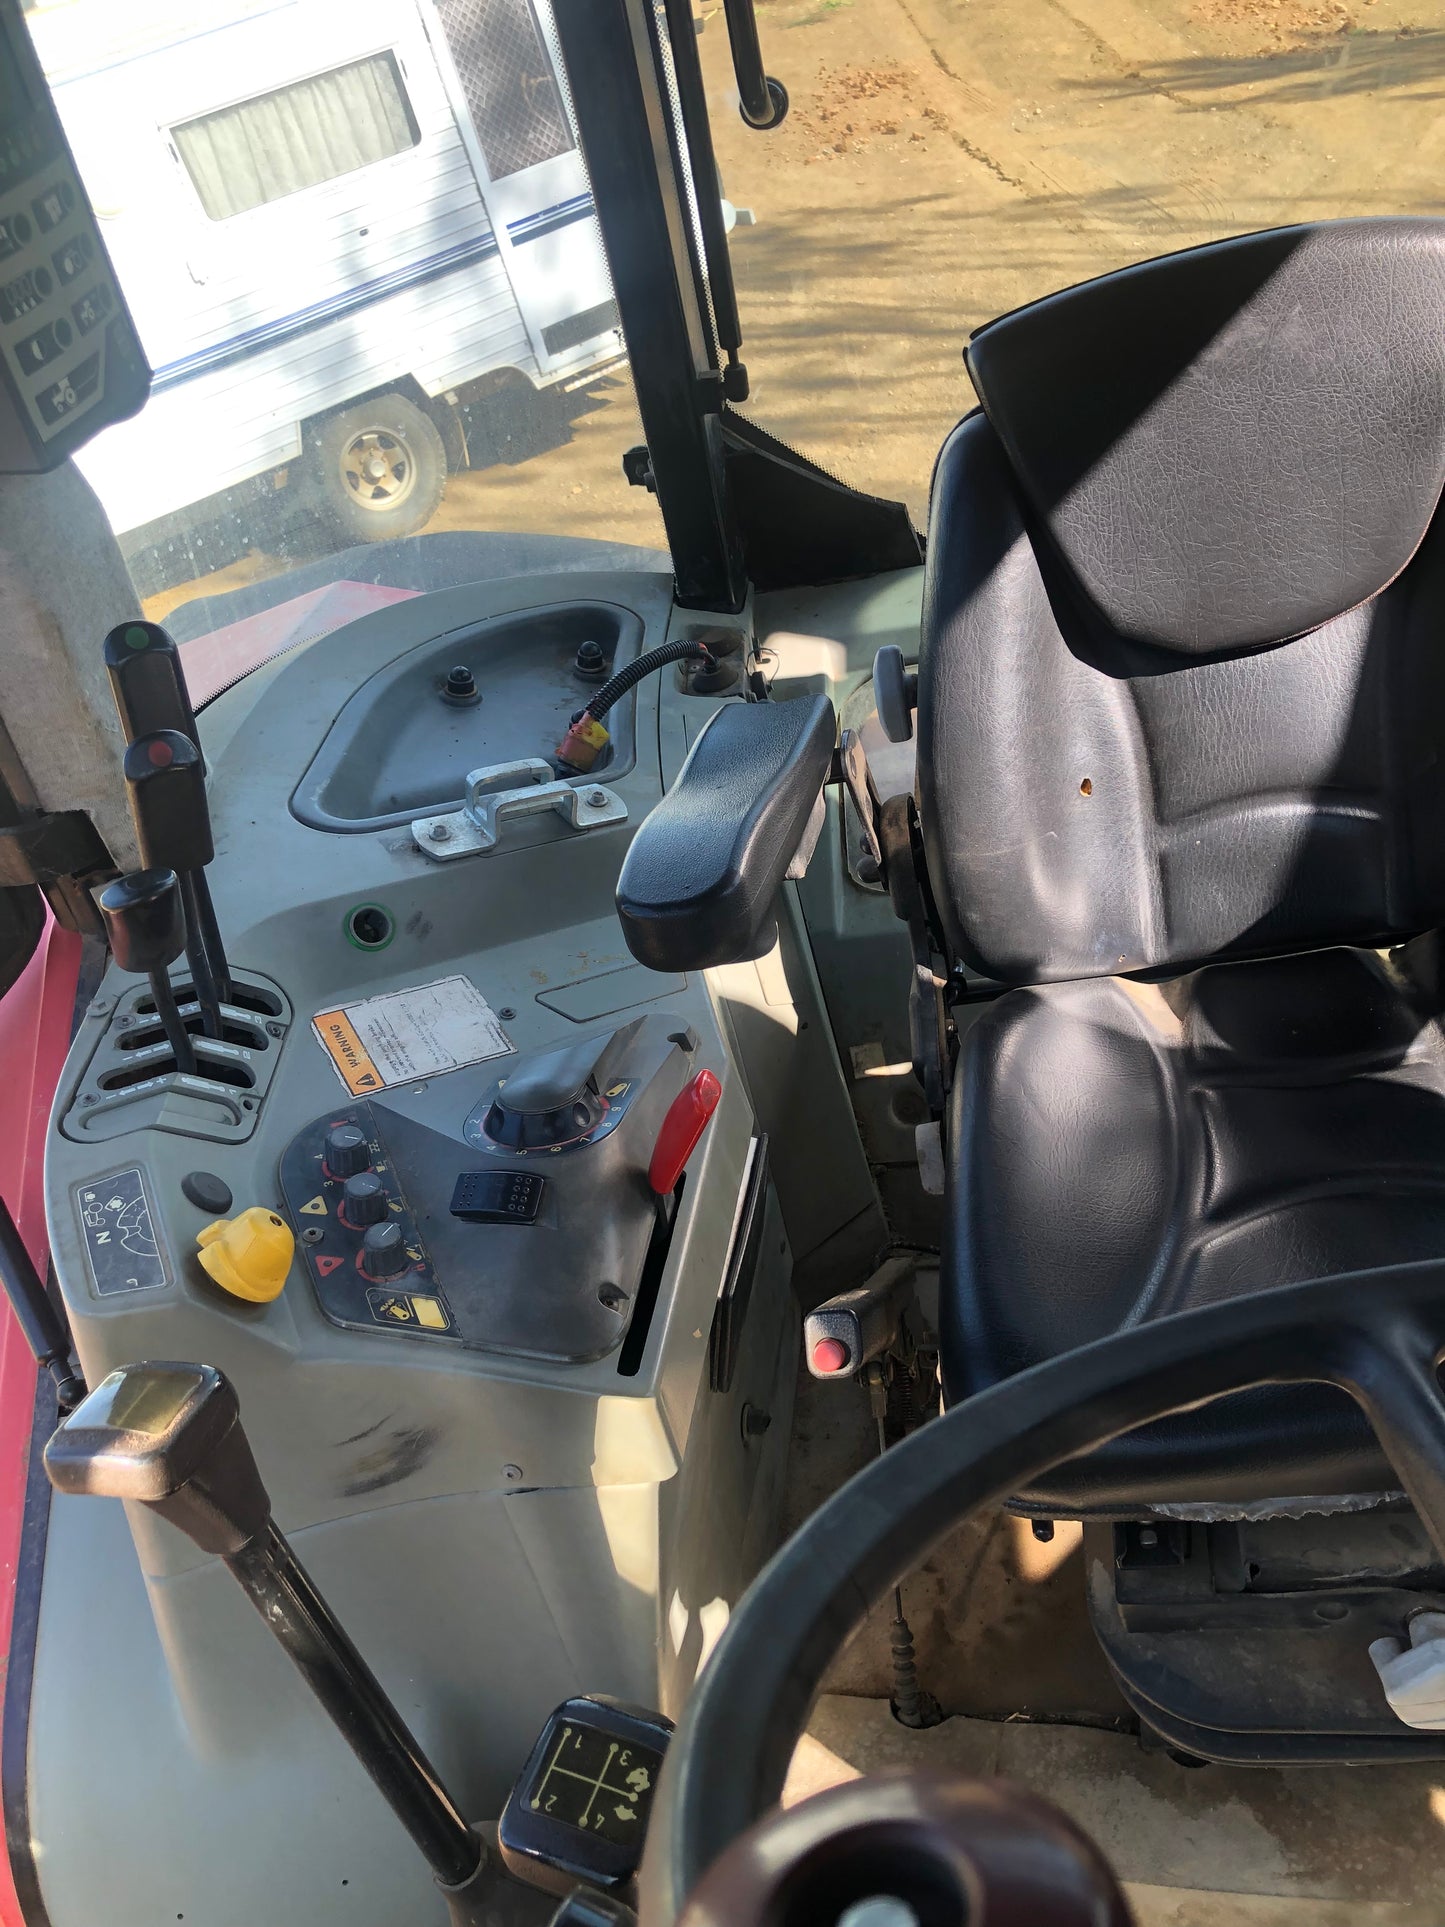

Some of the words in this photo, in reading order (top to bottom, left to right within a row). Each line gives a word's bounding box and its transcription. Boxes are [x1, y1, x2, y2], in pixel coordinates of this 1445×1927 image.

[330, 1023, 361, 1068] WARNING
[323, 1180, 334, 1188] 3
[95, 1230, 112, 1245] N
[575, 1734, 583, 1749] 1
[620, 1750, 632, 1766] 3
[545, 1794, 558, 1812] 2
[595, 1813, 605, 1830] 4
